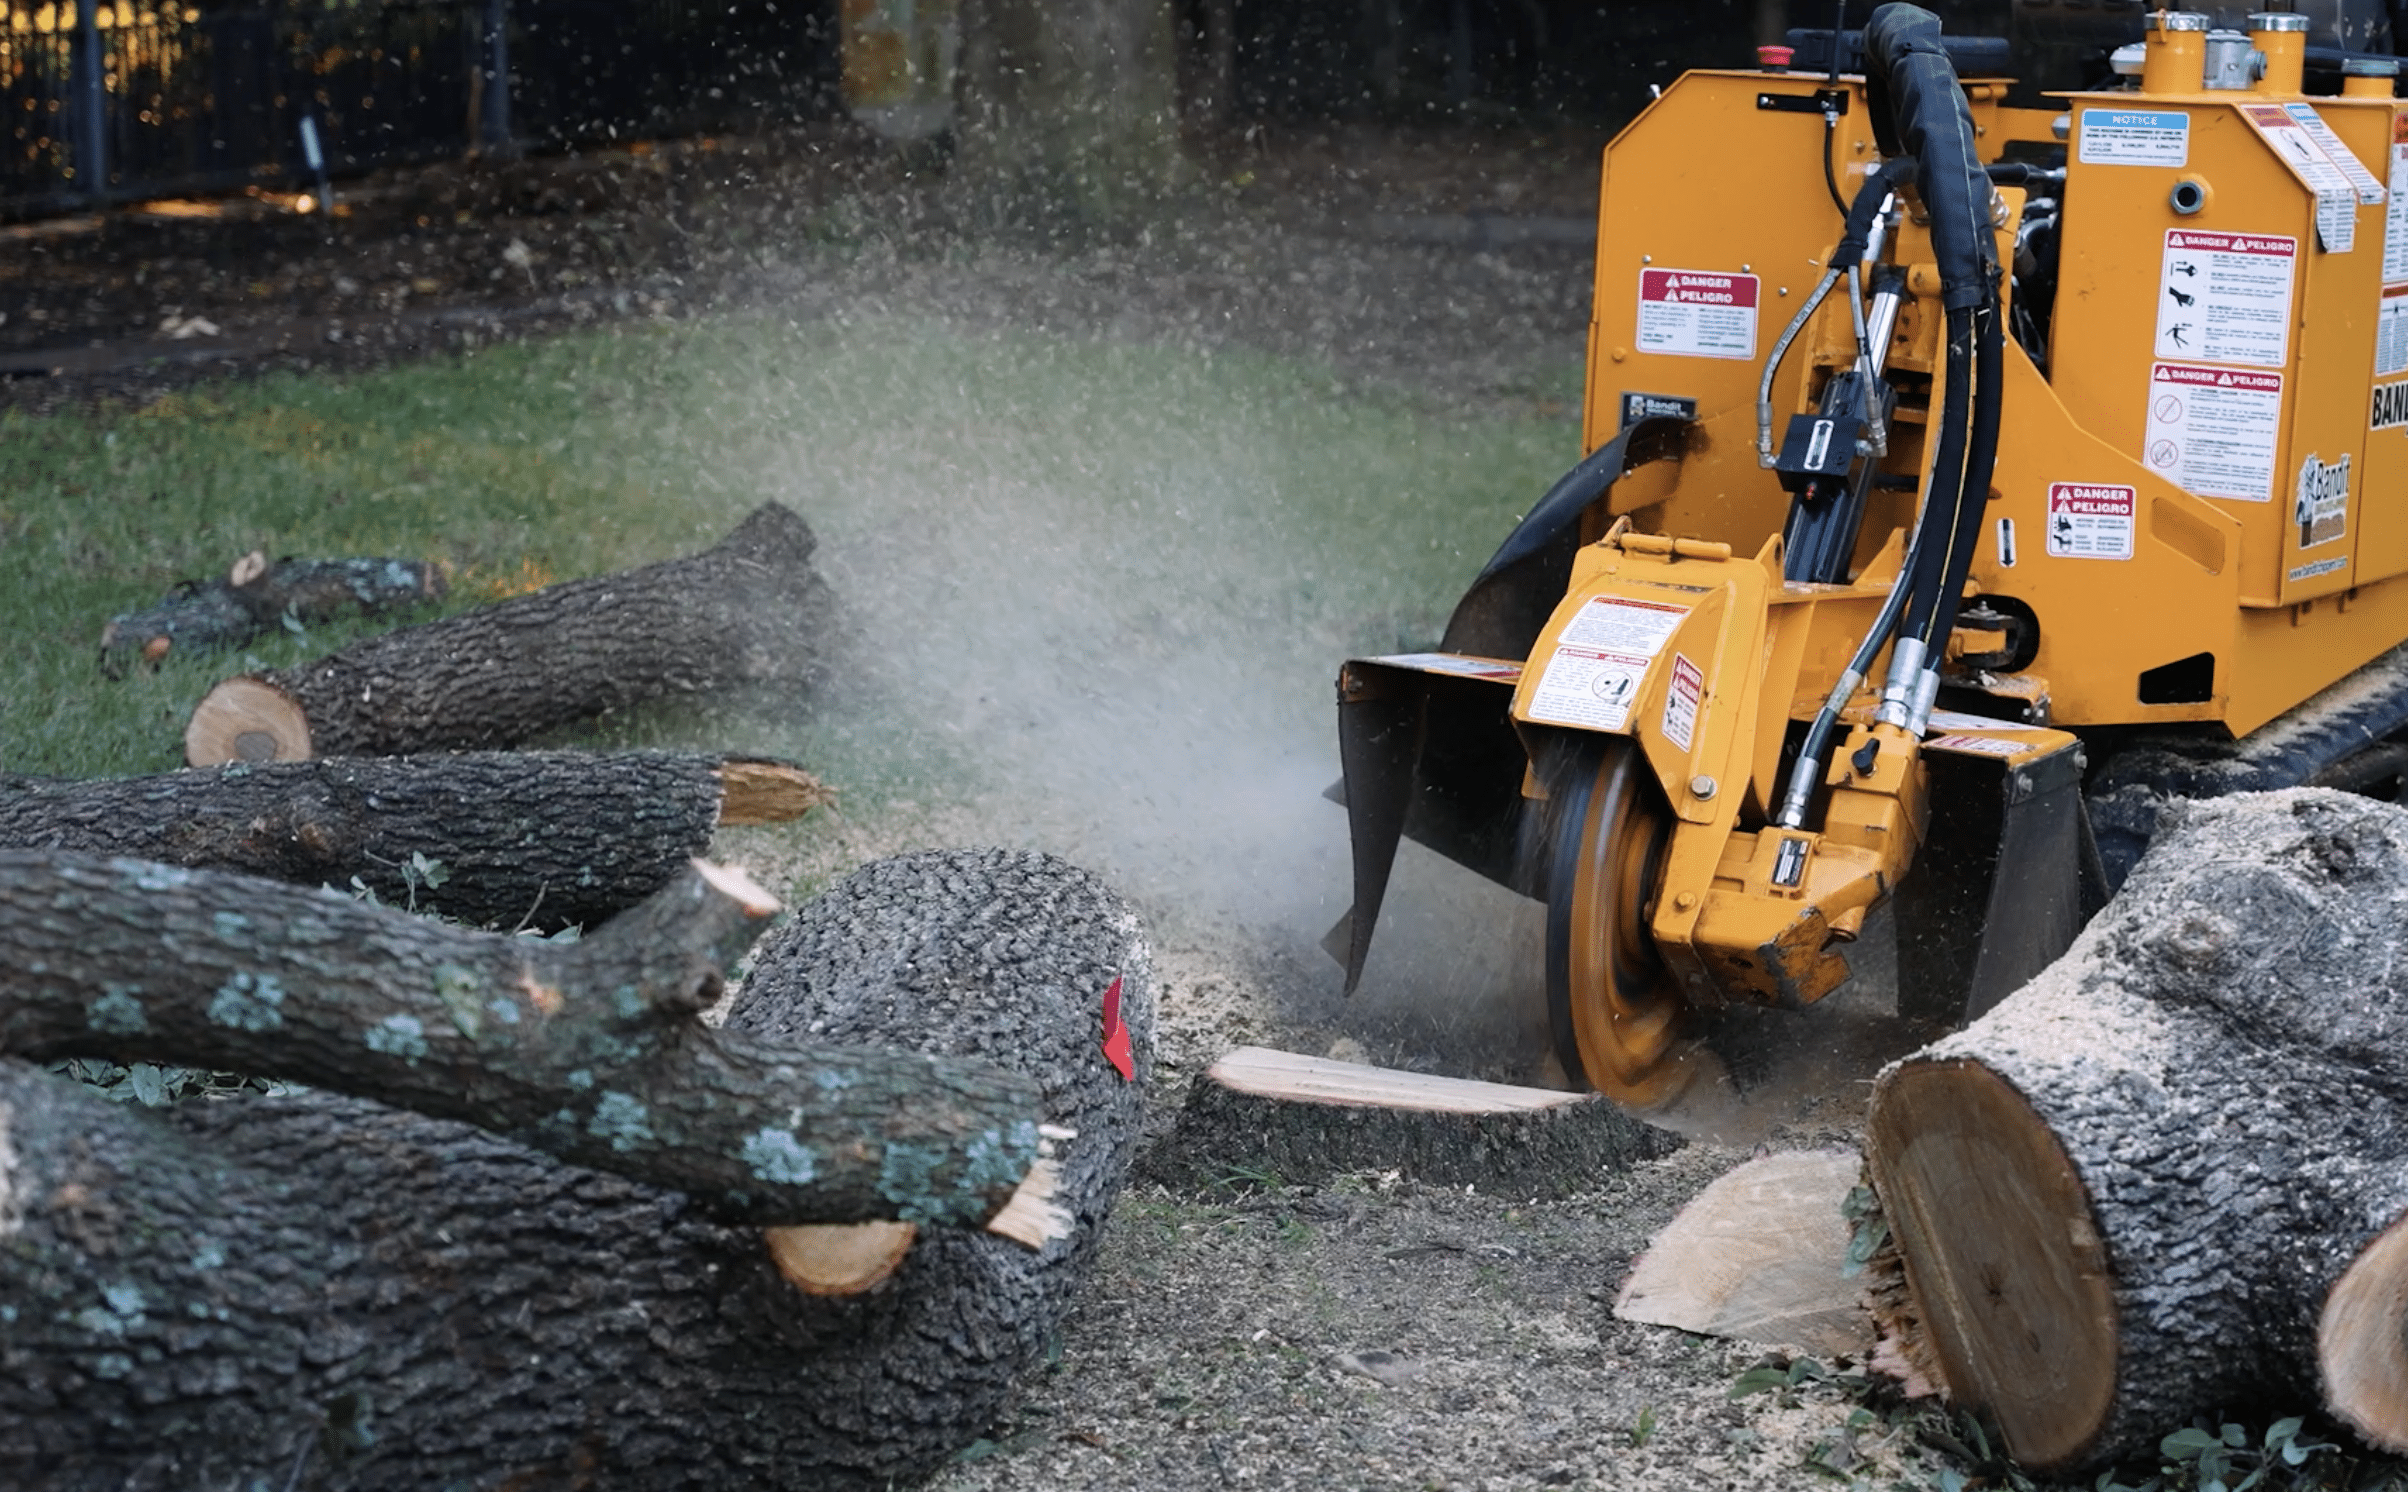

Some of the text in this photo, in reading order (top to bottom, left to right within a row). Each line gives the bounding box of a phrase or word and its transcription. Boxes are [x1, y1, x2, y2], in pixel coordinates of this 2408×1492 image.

[2112, 115, 2158, 126] NOTICE
[2185, 236, 2293, 252] DANGER PELIGRO
[1680, 275, 1732, 288] DANGER
[1680, 290, 1734, 304] PELIGRO
[2171, 369, 2280, 387] DANGER PELIGRO
[1646, 399, 1682, 411] Bandit
[2315, 461, 2350, 501] Bandit
[2073, 488, 2129, 500] DANGER
[2072, 501, 2130, 514] PELIGRO
